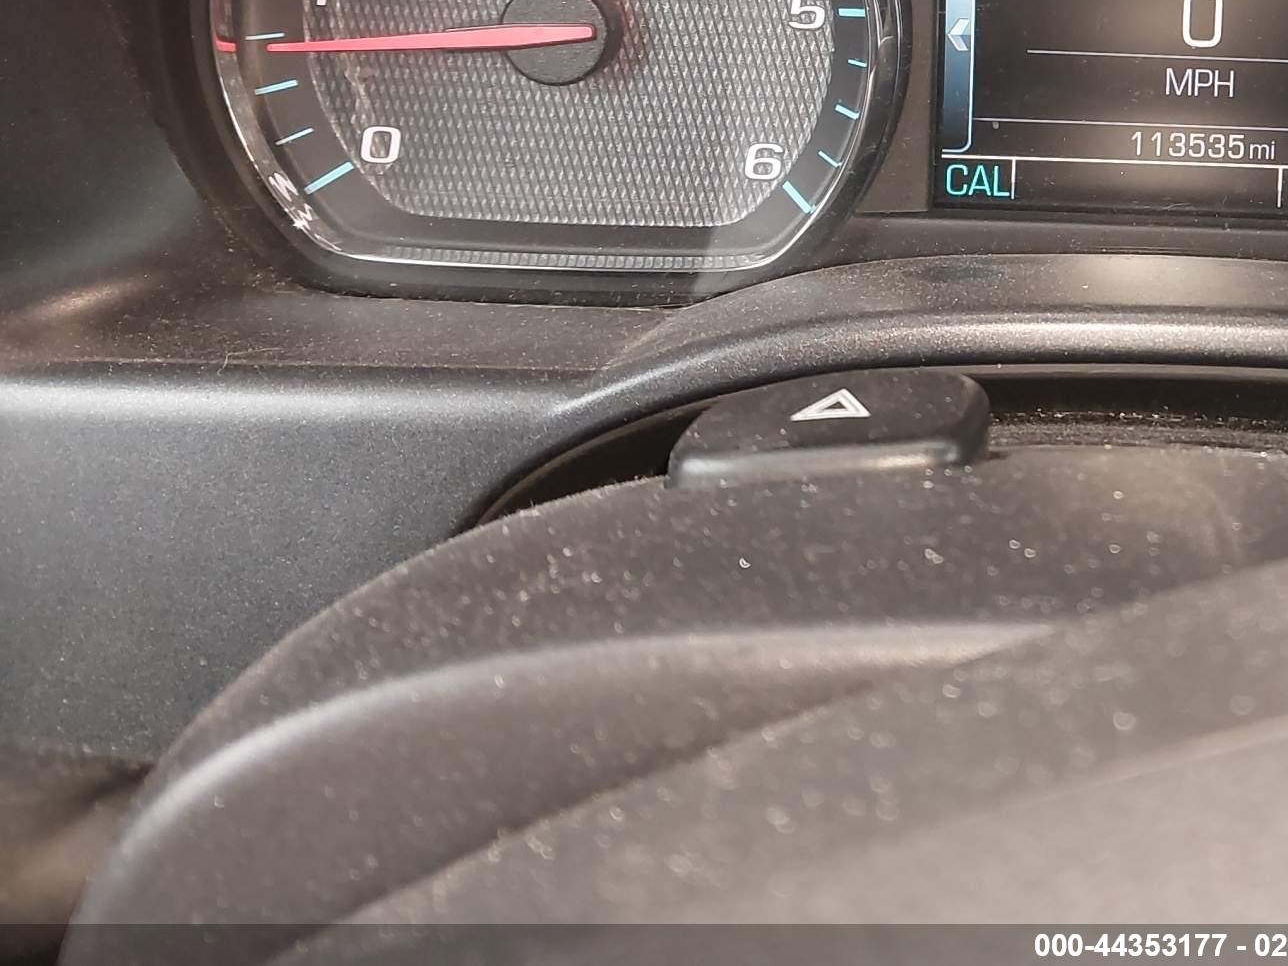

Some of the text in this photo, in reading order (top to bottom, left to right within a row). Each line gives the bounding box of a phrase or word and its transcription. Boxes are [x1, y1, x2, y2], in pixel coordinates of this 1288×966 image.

[1164, 67, 1235, 98] MPH
[360, 126, 402, 165] 0
[744, 143, 785, 182] 6
[1131, 131, 1246, 161] 113535
[945, 164, 1010, 198] CAL
